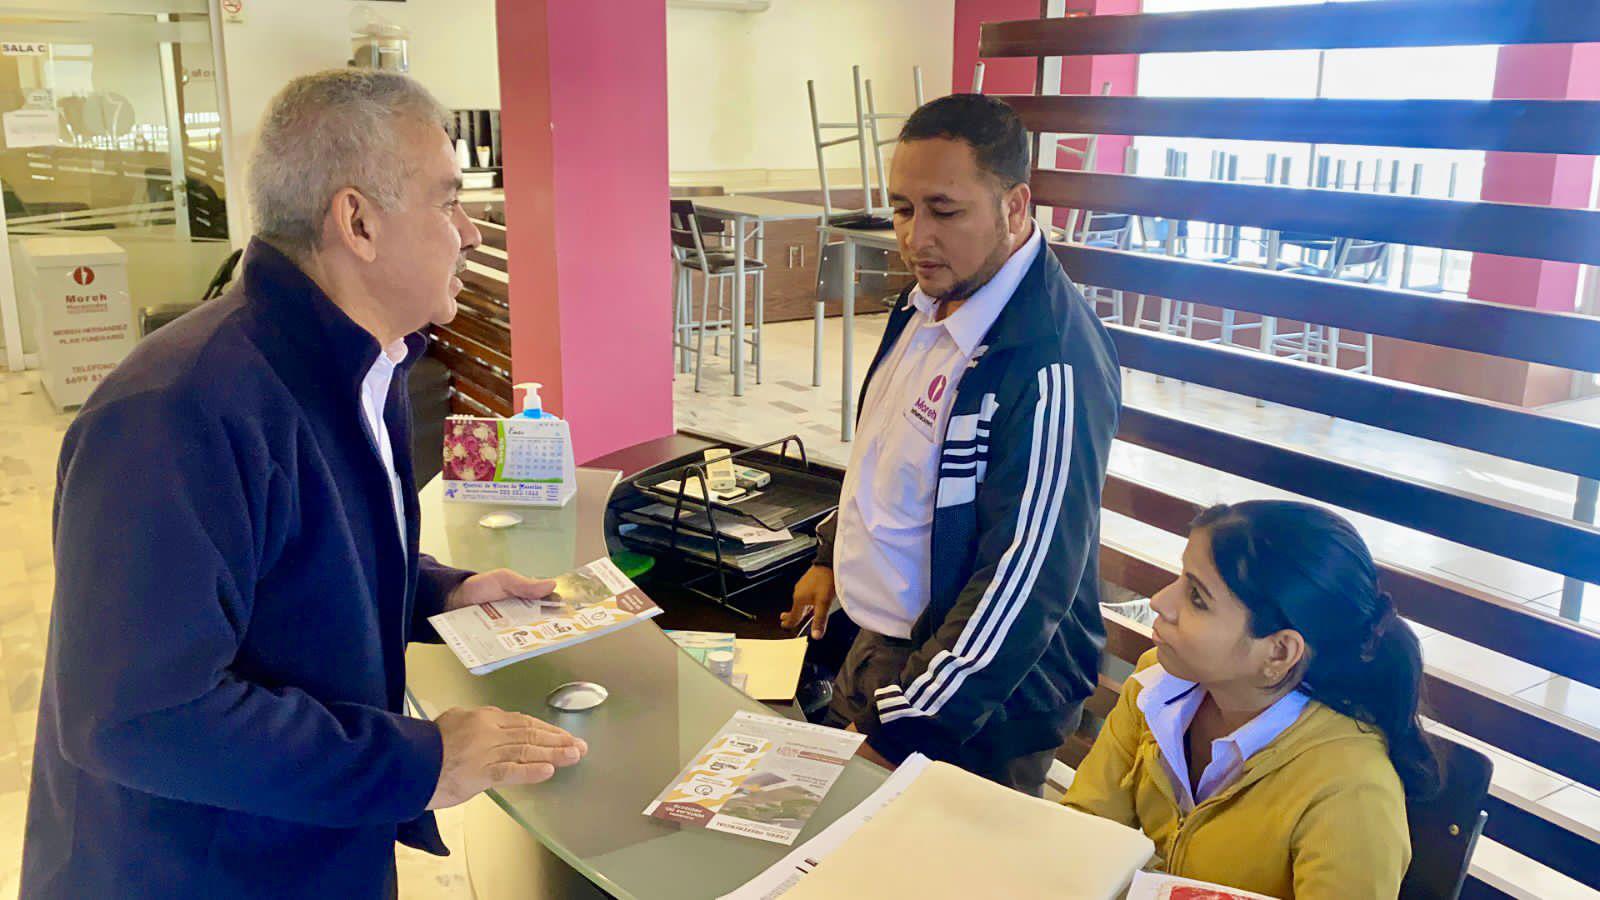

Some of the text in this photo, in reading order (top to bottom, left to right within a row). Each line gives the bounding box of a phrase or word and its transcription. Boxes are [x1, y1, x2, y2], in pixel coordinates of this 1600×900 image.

[3, 43, 46, 52] SALA C
[65, 294, 107, 303] Moreh
[915, 398, 936, 420] Moreh
